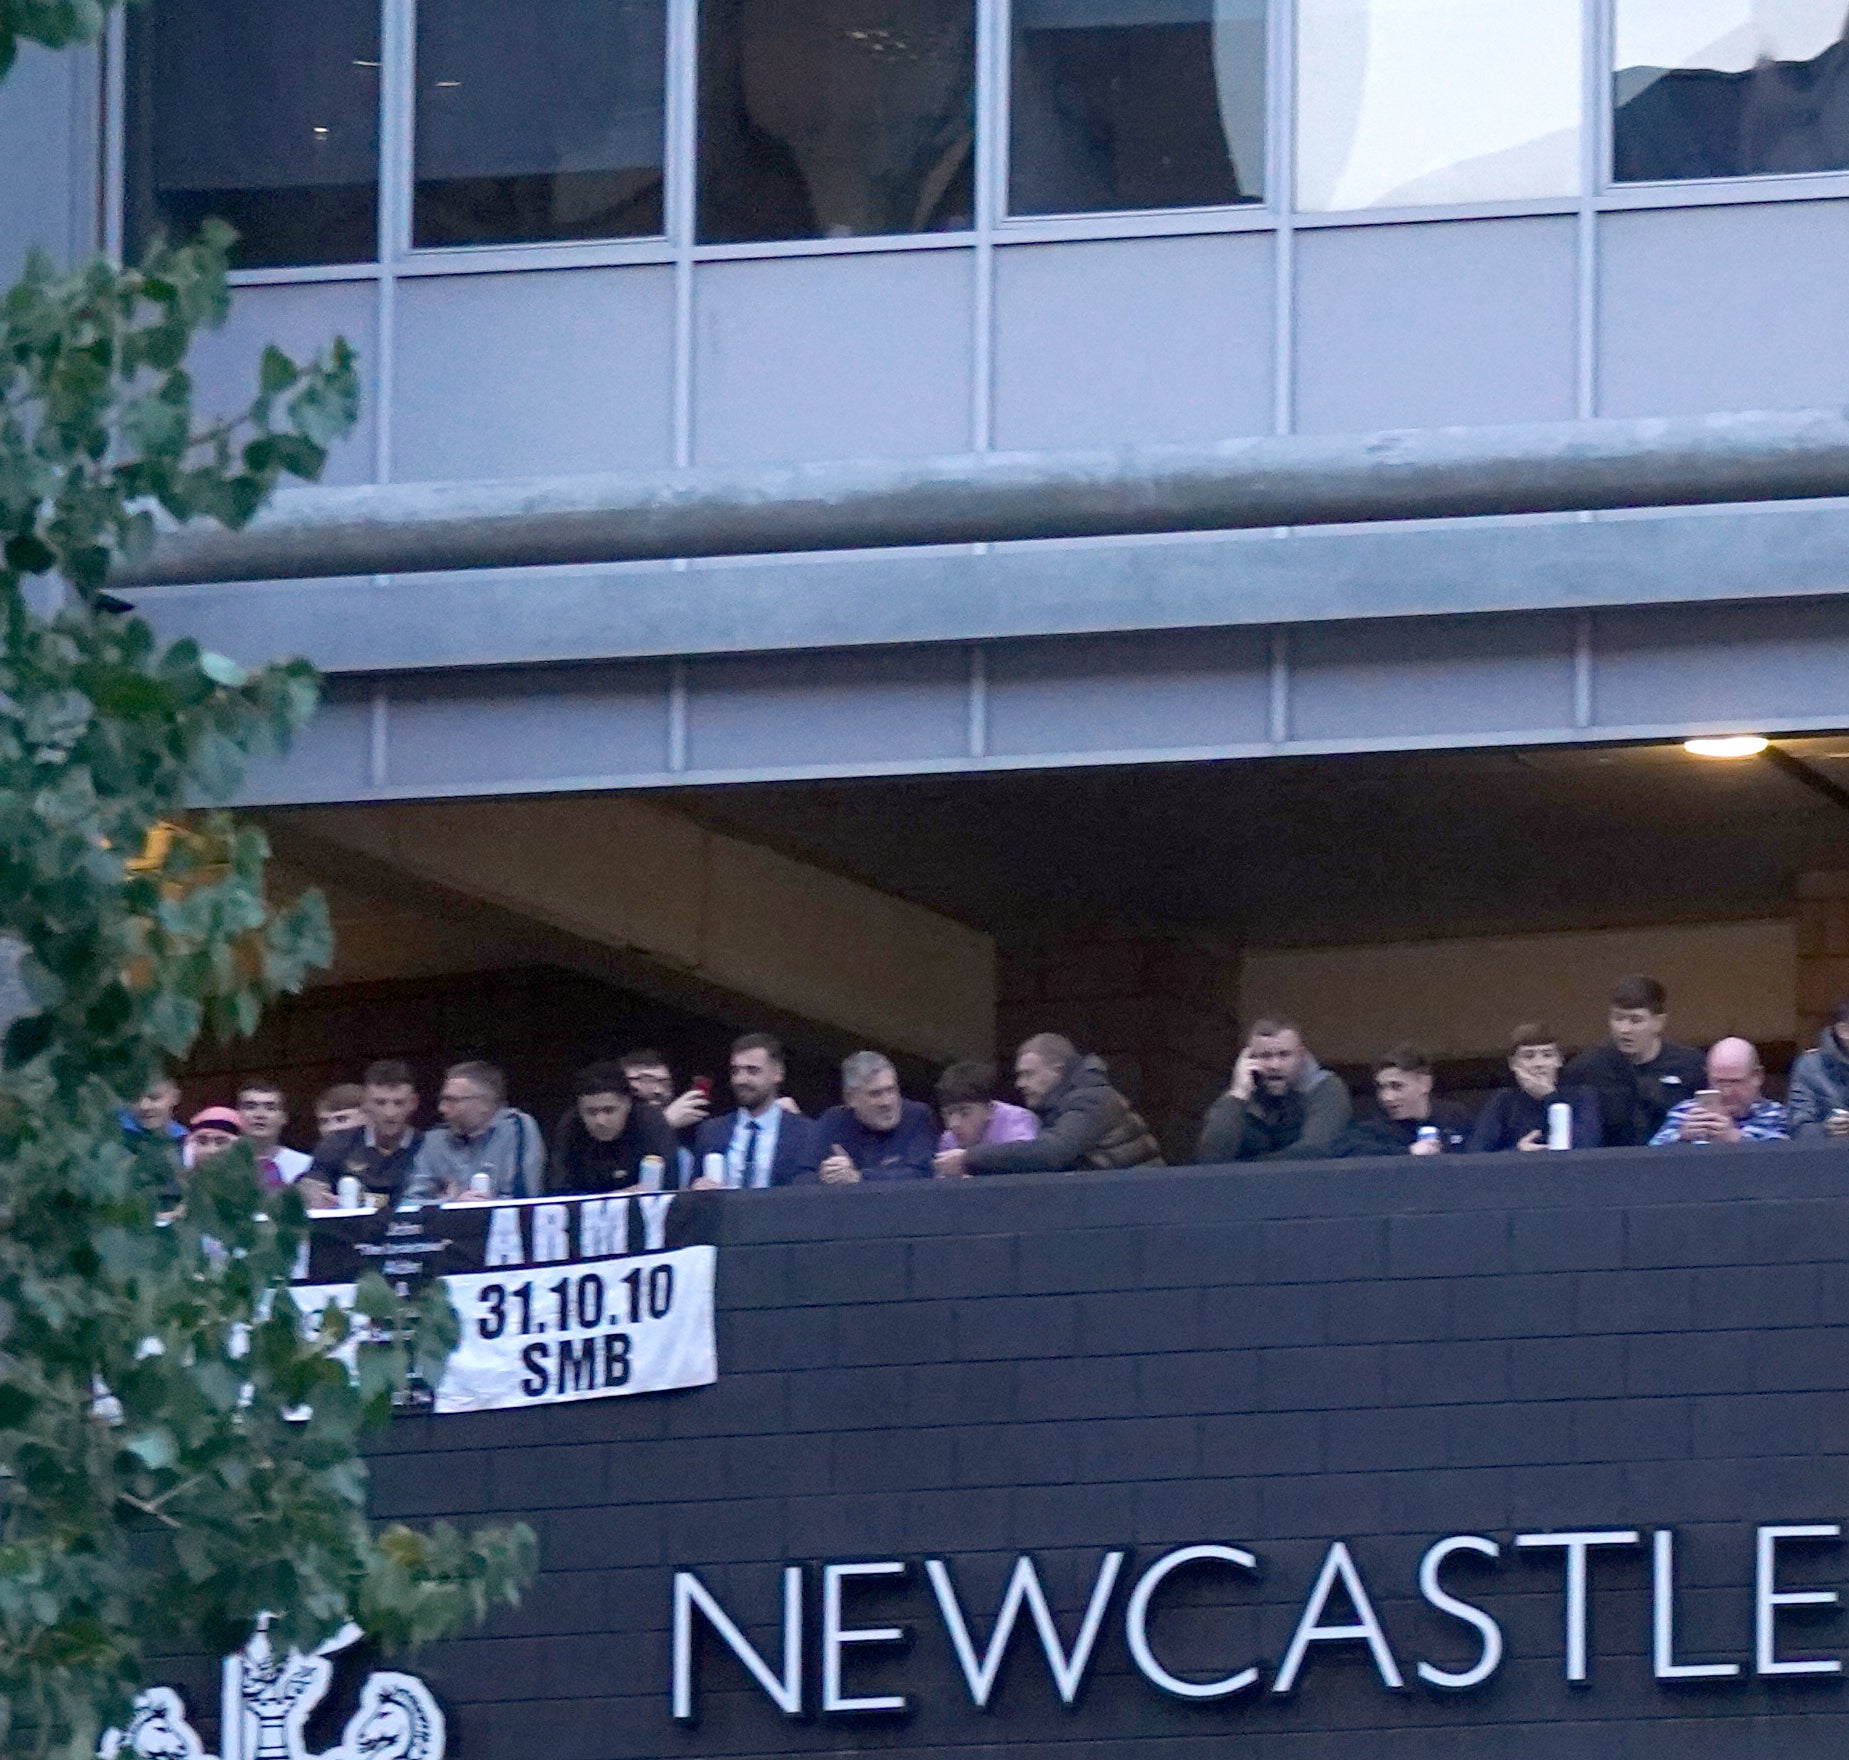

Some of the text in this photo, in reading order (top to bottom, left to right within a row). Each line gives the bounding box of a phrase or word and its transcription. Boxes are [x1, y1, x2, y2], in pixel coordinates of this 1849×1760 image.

[485, 1193, 677, 1267] ARMY
[477, 1263, 675, 1341] 31.10.10
[521, 1333, 631, 1398] SMB
[671, 1524, 1842, 1719] NEWCASTLE
